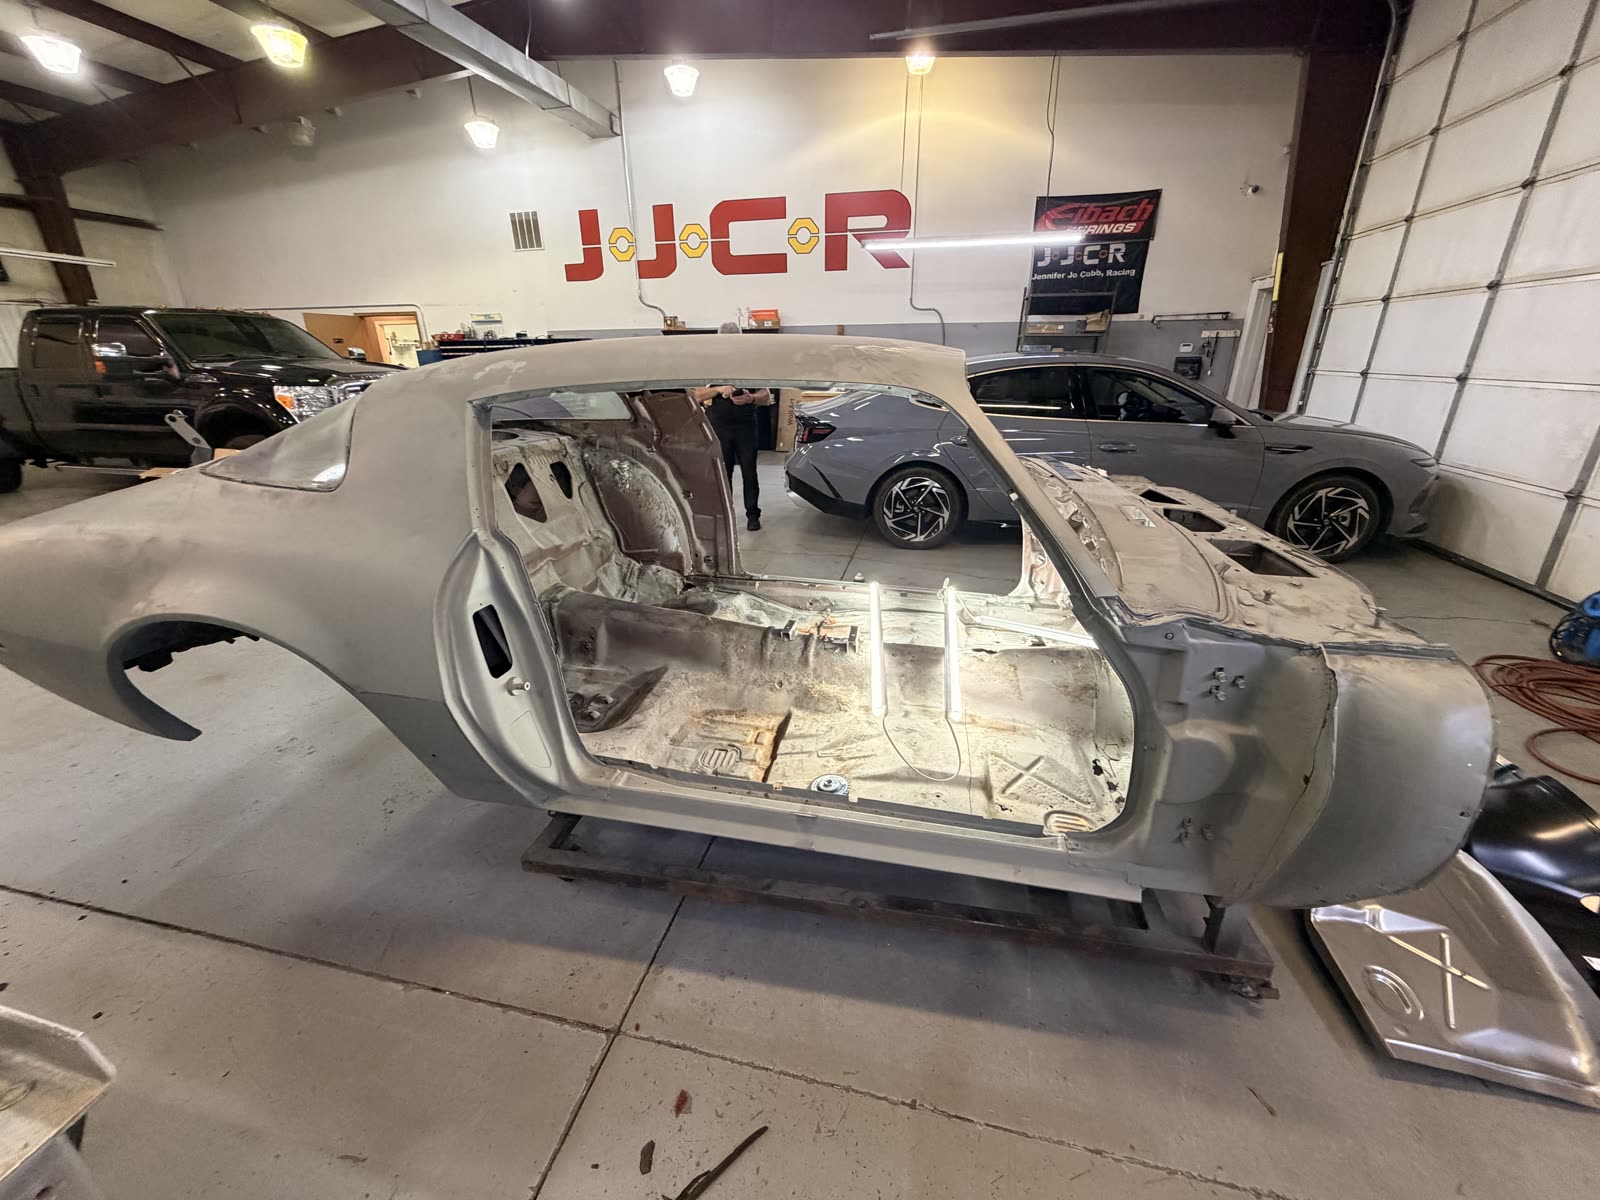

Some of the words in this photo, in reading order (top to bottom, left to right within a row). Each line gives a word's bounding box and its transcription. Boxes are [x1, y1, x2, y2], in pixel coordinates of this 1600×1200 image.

[1035, 198, 1155, 233] Eibach
[1032, 271, 1066, 281] Jennifer
[1067, 271, 1078, 279] Jo
[1080, 269, 1104, 278] Cobb,
[1106, 268, 1136, 277] Racing
